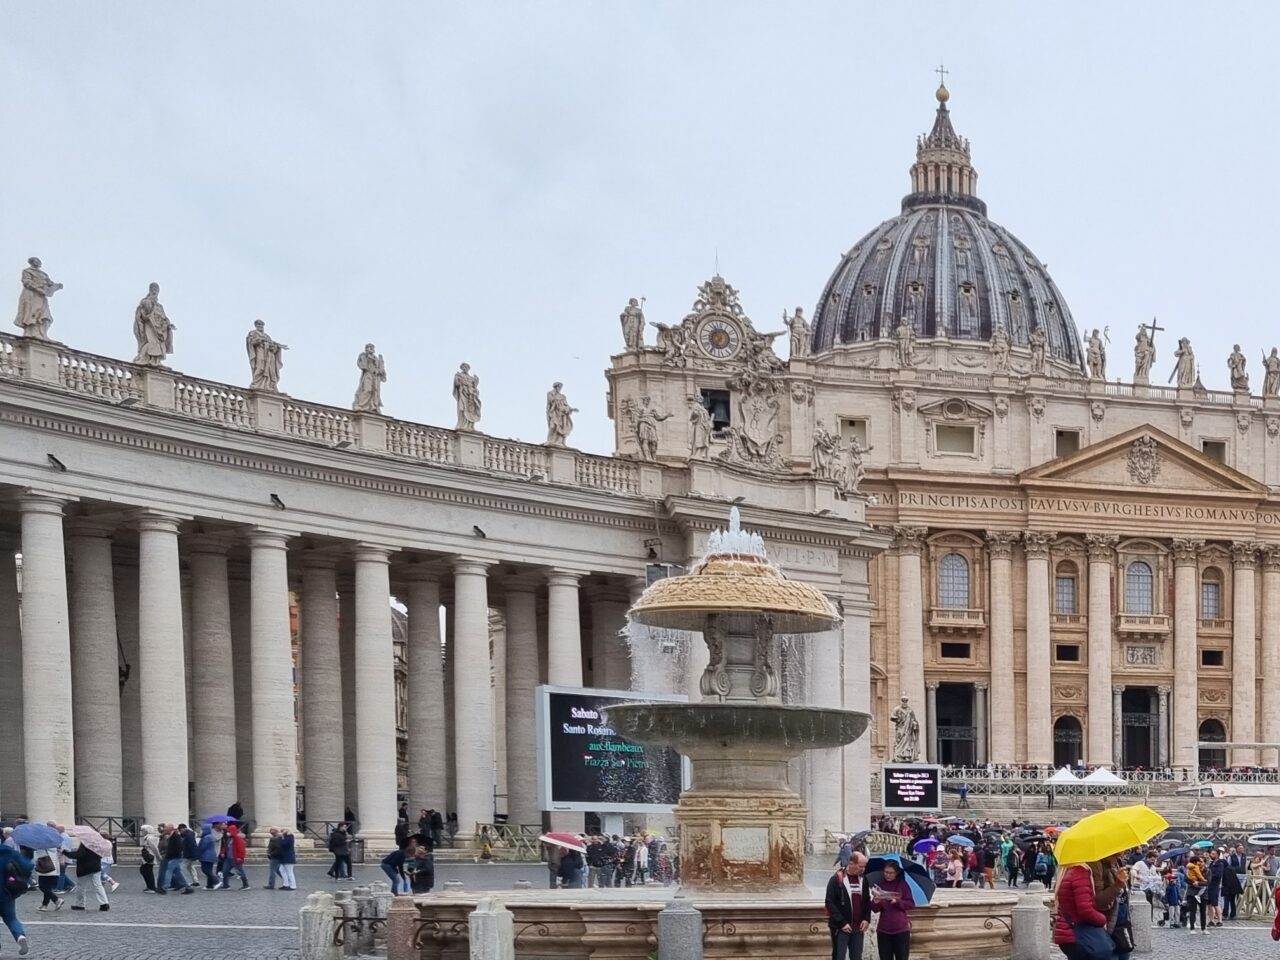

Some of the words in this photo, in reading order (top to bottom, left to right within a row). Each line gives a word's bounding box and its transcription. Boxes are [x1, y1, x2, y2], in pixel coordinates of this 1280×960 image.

[900, 492, 977, 508] PRINCIPIS
[1030, 498, 1079, 512] PAVLVS
[1093, 502, 1182, 518] BVRGHESIVS
[1184, 507, 1256, 522] ROMANVS
[563, 723, 586, 734] Santo
